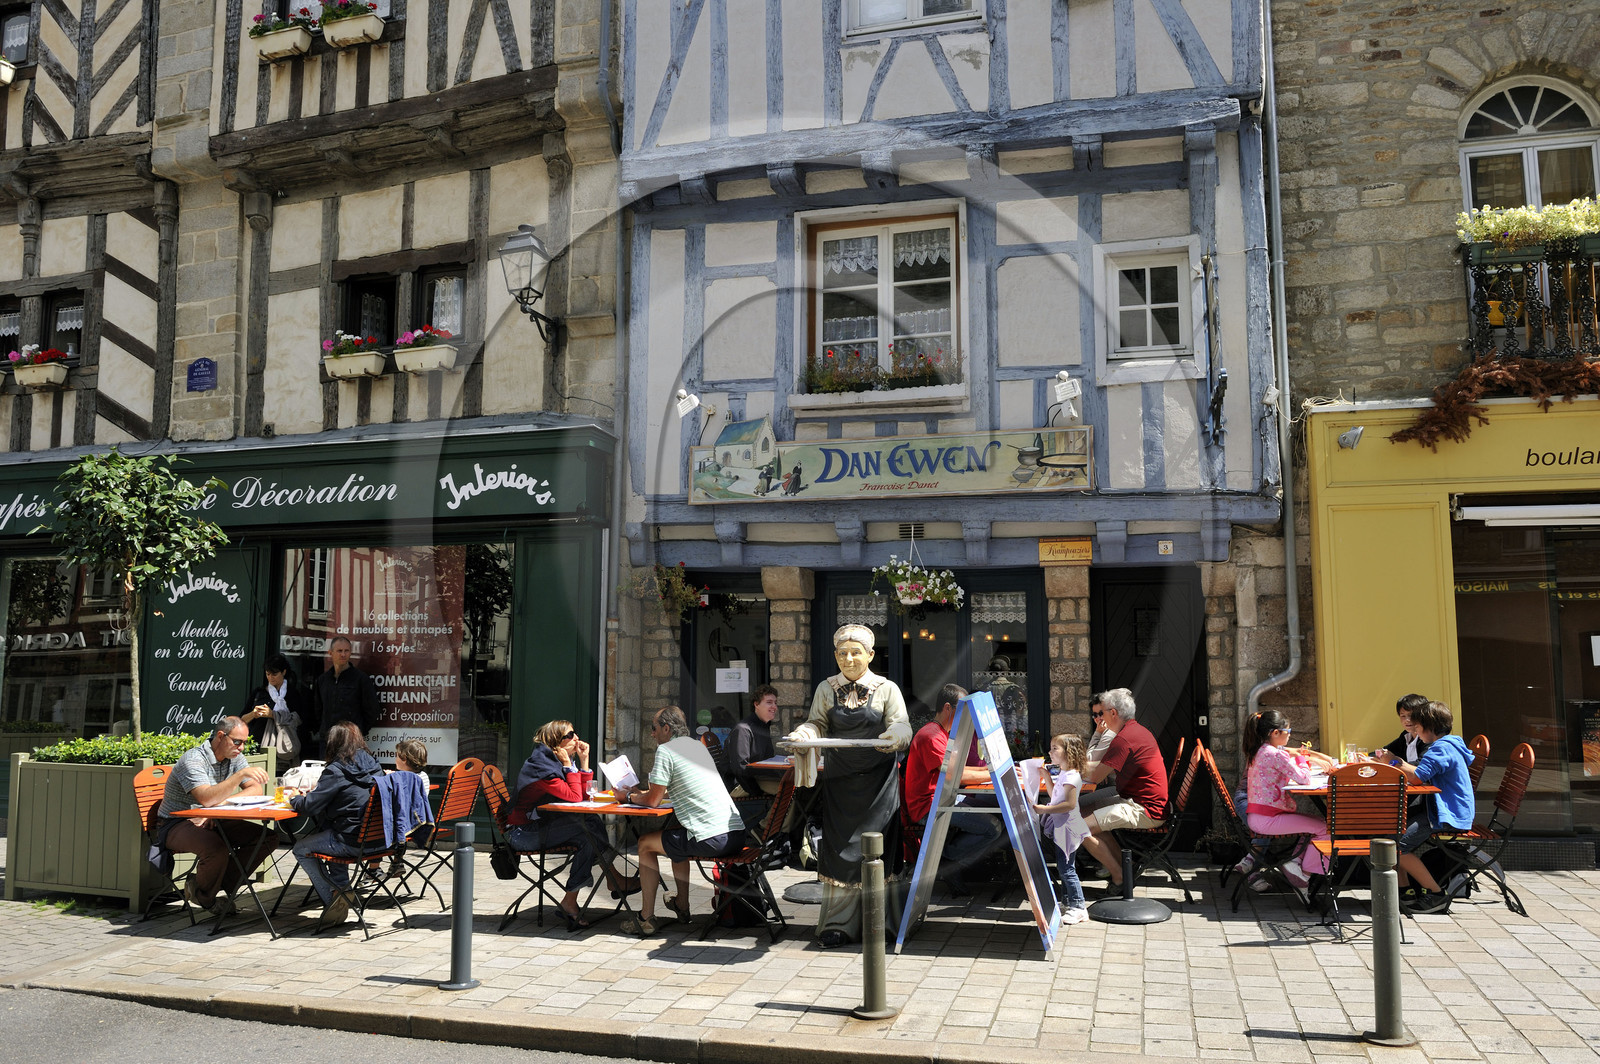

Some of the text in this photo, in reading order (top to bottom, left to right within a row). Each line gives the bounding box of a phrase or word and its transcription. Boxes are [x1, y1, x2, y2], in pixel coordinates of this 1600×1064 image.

[814, 440, 1002, 483] DAN EWEN
[1525, 446, 1600, 467] boula
[231, 473, 399, 510] Décoration
[363, 609, 428, 621] 16 collections
[171, 619, 229, 638] Meubles
[336, 624, 453, 637] de meubles et canapés
[154, 639, 245, 659] en Pin Cirés
[371, 641, 384, 653] 16
[385, 642, 415, 655] styles
[167, 672, 227, 698] Canapés
[166, 704, 203, 730] Objets
[390, 707, 454, 725] d'exposition
[372, 734, 379, 742] et
[380, 731, 397, 744] plan
